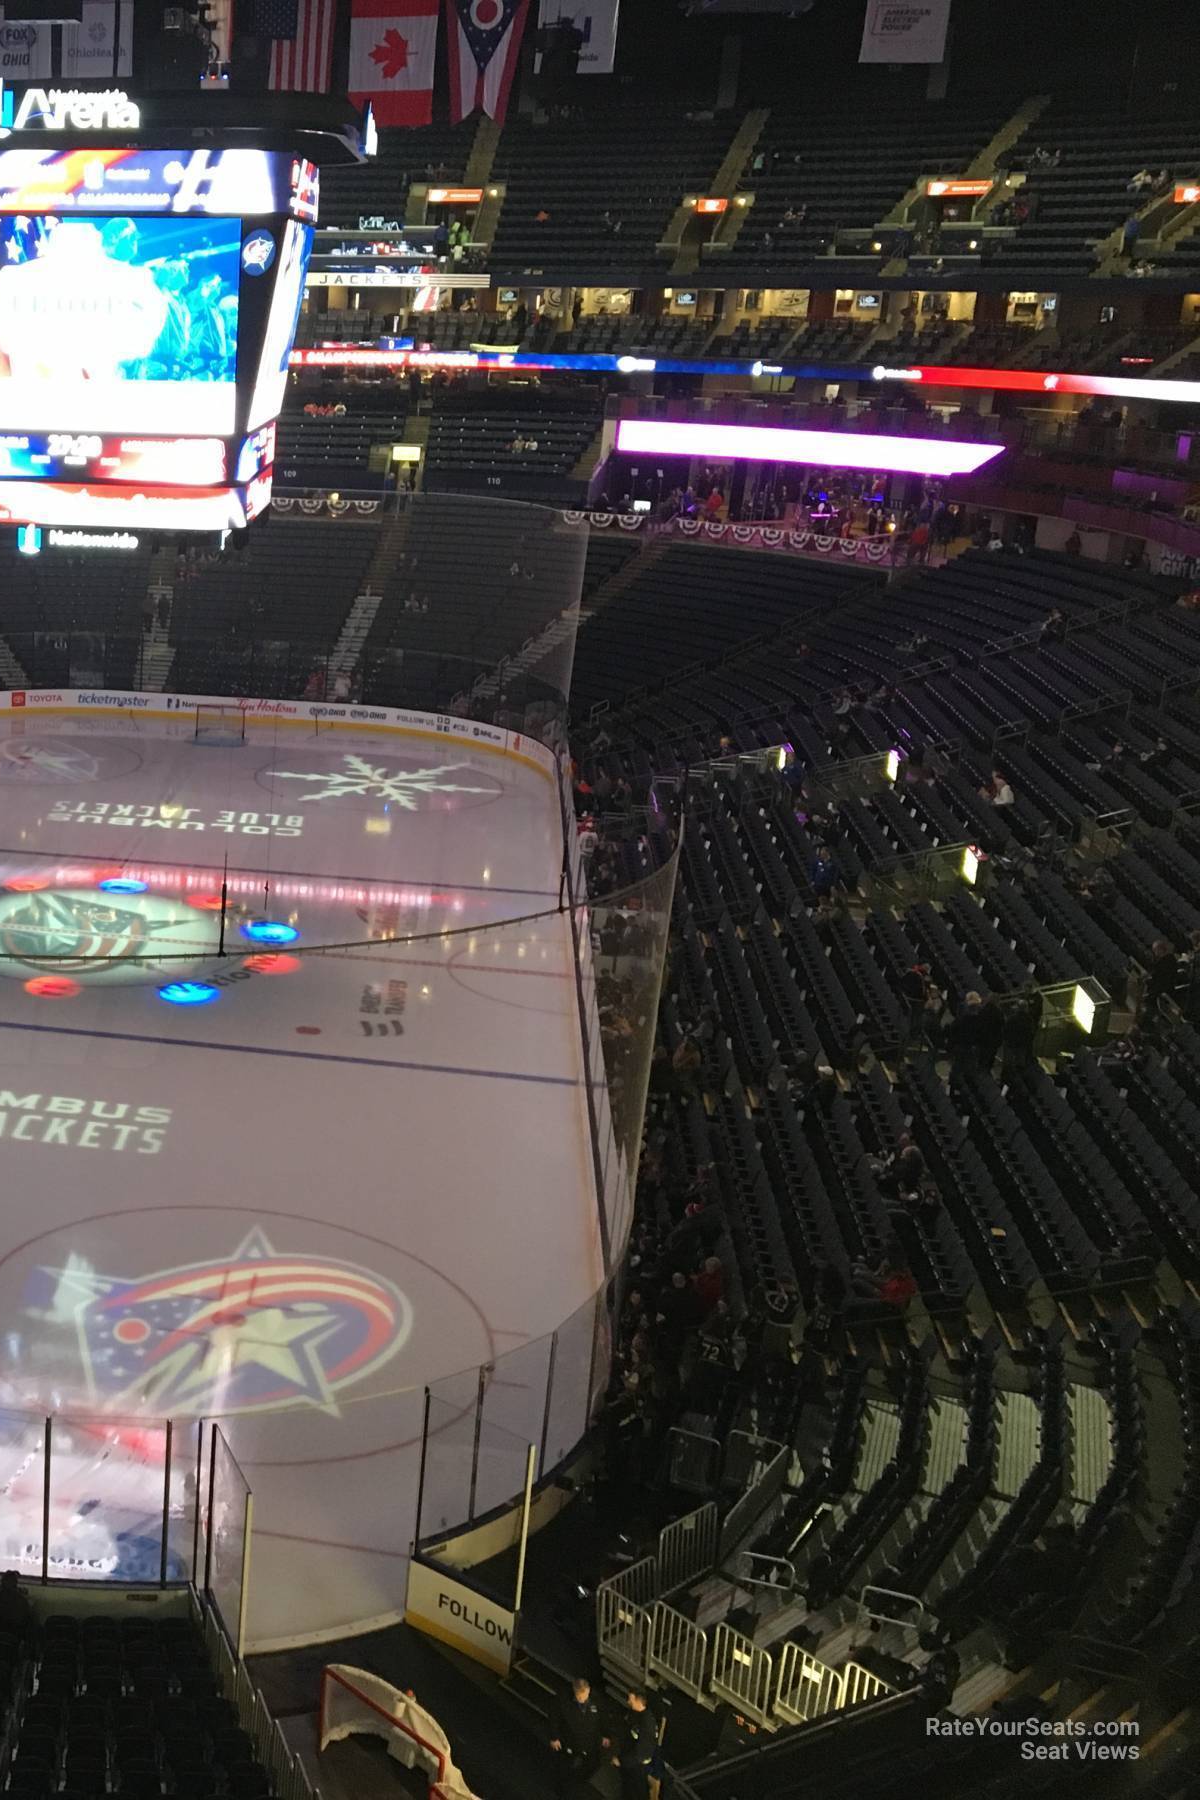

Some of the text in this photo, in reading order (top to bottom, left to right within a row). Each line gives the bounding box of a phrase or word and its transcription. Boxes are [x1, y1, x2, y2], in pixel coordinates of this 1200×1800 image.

[5, 28, 28, 41] FOX
[2, 53, 30, 66] OHIO
[68, 48, 126, 58] OhioHeah
[14, 89, 140, 129] Arena
[319, 274, 422, 285] JACKETS
[283, 470, 297, 478] 109
[487, 477, 500, 486] 110
[50, 530, 138, 549] Nationwide
[29, 694, 63, 704] TOYOTA
[77, 693, 150, 708] ticketmaster
[237, 698, 255, 710] Tim
[255, 699, 297, 714] Hortons
[50, 800, 305, 827] BLUE JACKETS
[47, 812, 303, 837] COLUMBUS
[438, 1592, 511, 1647] FOLLOW
